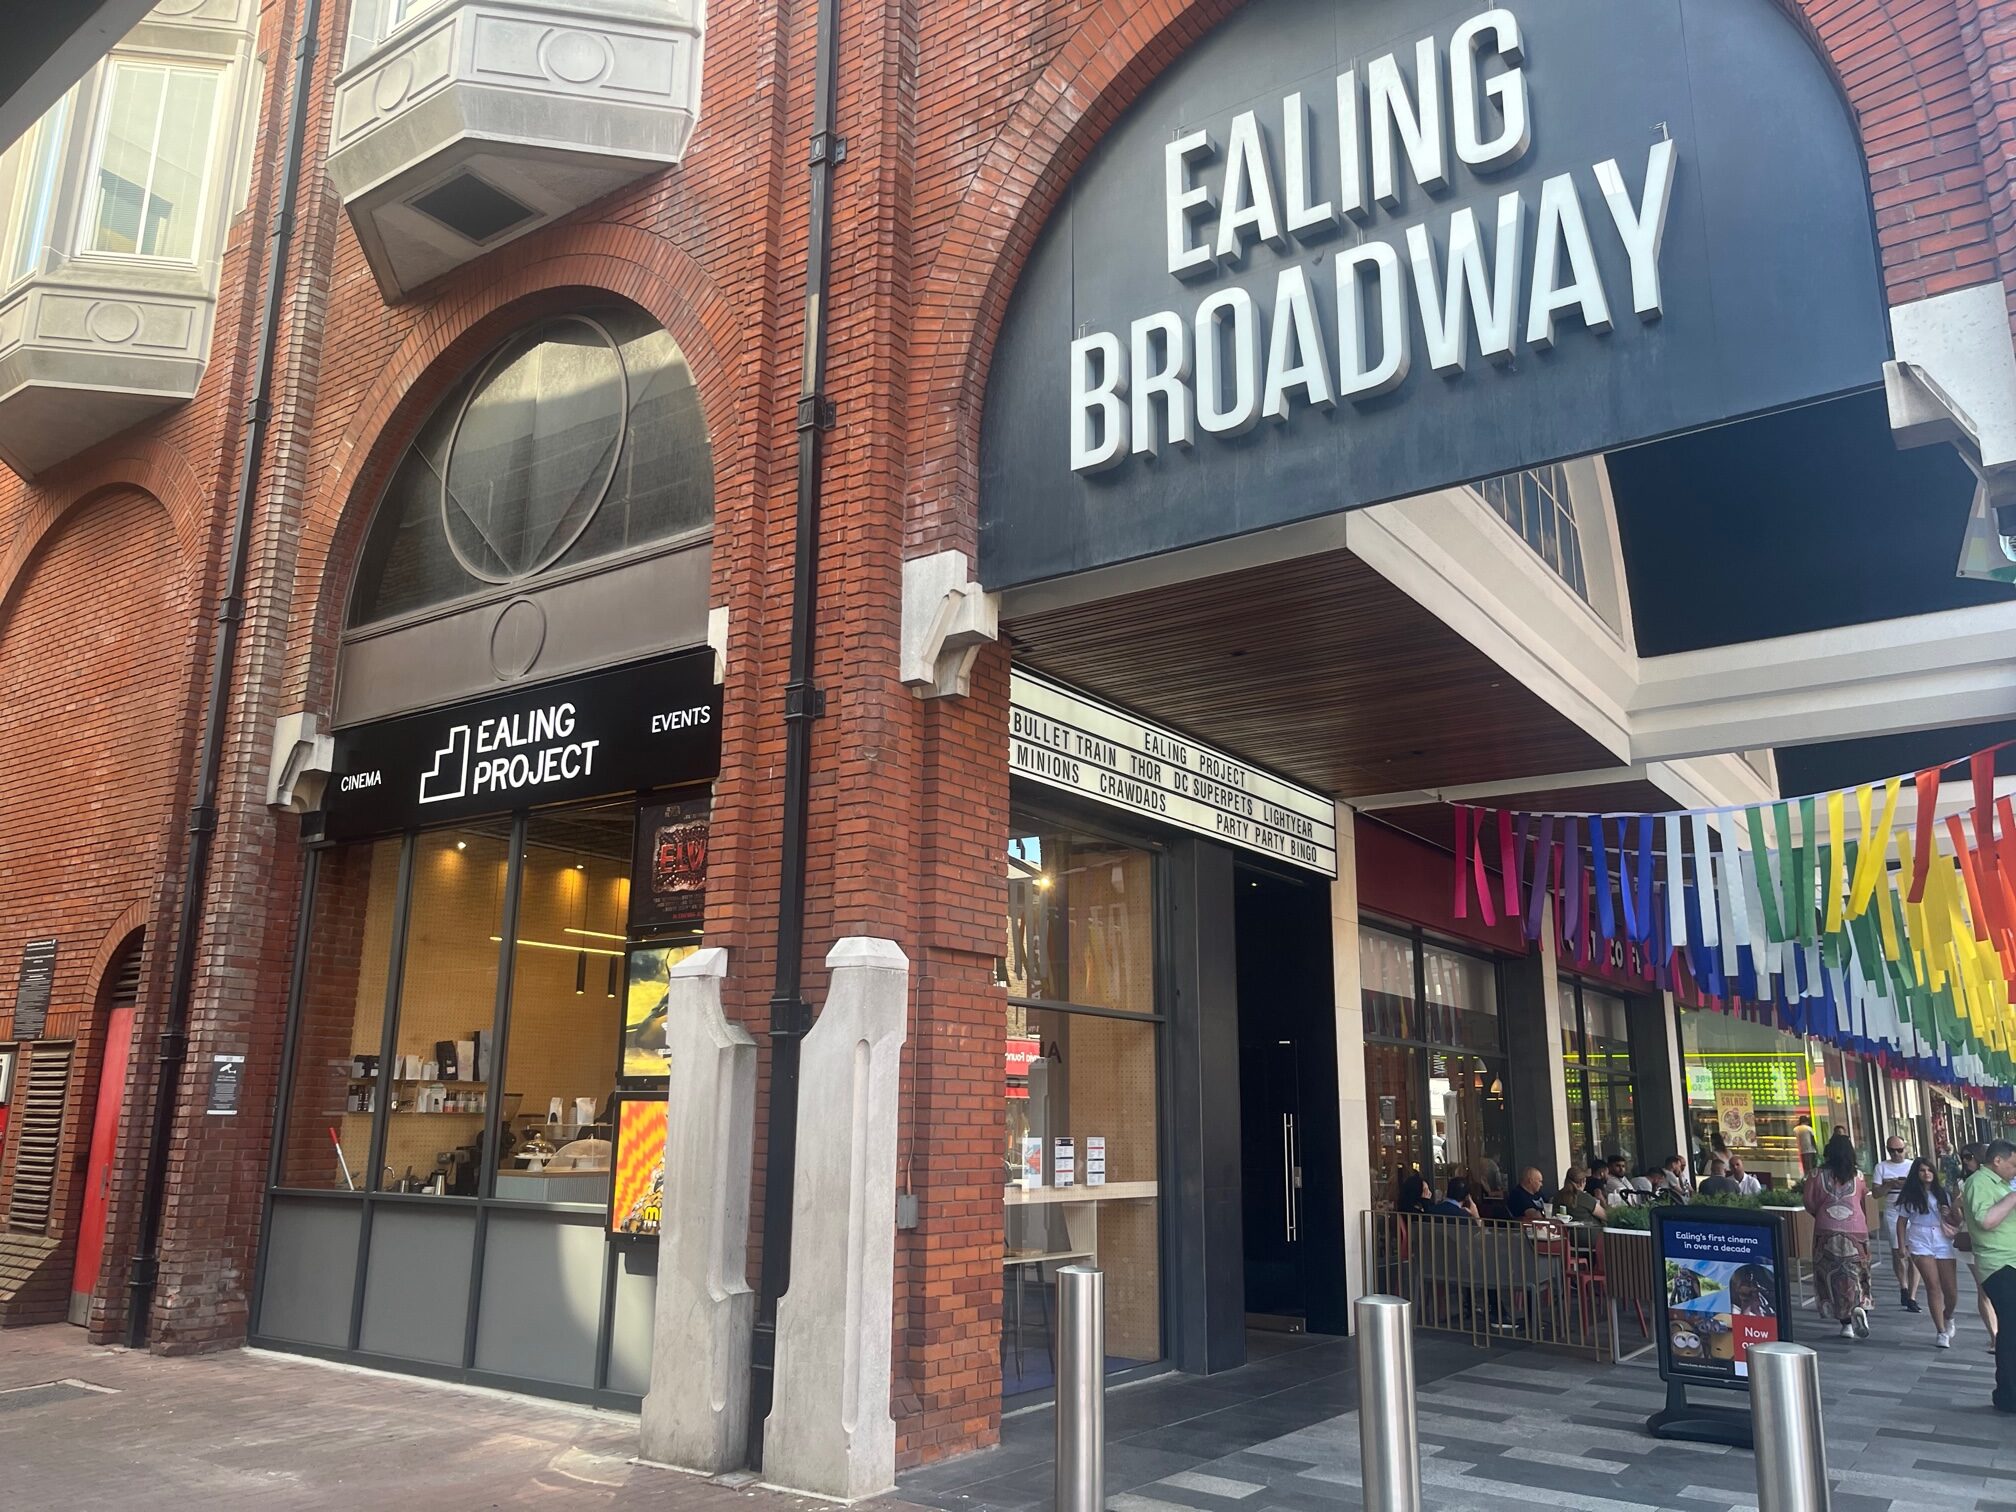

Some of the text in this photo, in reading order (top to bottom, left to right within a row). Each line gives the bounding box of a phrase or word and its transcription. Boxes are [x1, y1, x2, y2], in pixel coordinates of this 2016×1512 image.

[1165, 8, 1531, 280] EALING
[1071, 139, 1677, 473] BROADWAY
[476, 702, 576, 754] EALING
[651, 705, 711, 734] EVENTS
[340, 769, 382, 793] CINEMA
[473, 740, 600, 795] PROJECT
[1014, 711, 1313, 839] BULLET TRAIN THOR DC SUPERPETS LIGHTYEAR
[1145, 732, 1246, 788] EALING PROJECT
[1017, 744, 1317, 863] MINIONS CRAWDADS PARTY PARTY BINGO
[659, 840, 707, 874] ELV
[1675, 1231, 1758, 1244] Ealing's first cinema
[1683, 1241, 1692, 1249] in
[1693, 1243, 1711, 1251] over
[1720, 1244, 1751, 1253] decade
[1744, 1326, 1768, 1339] Now
